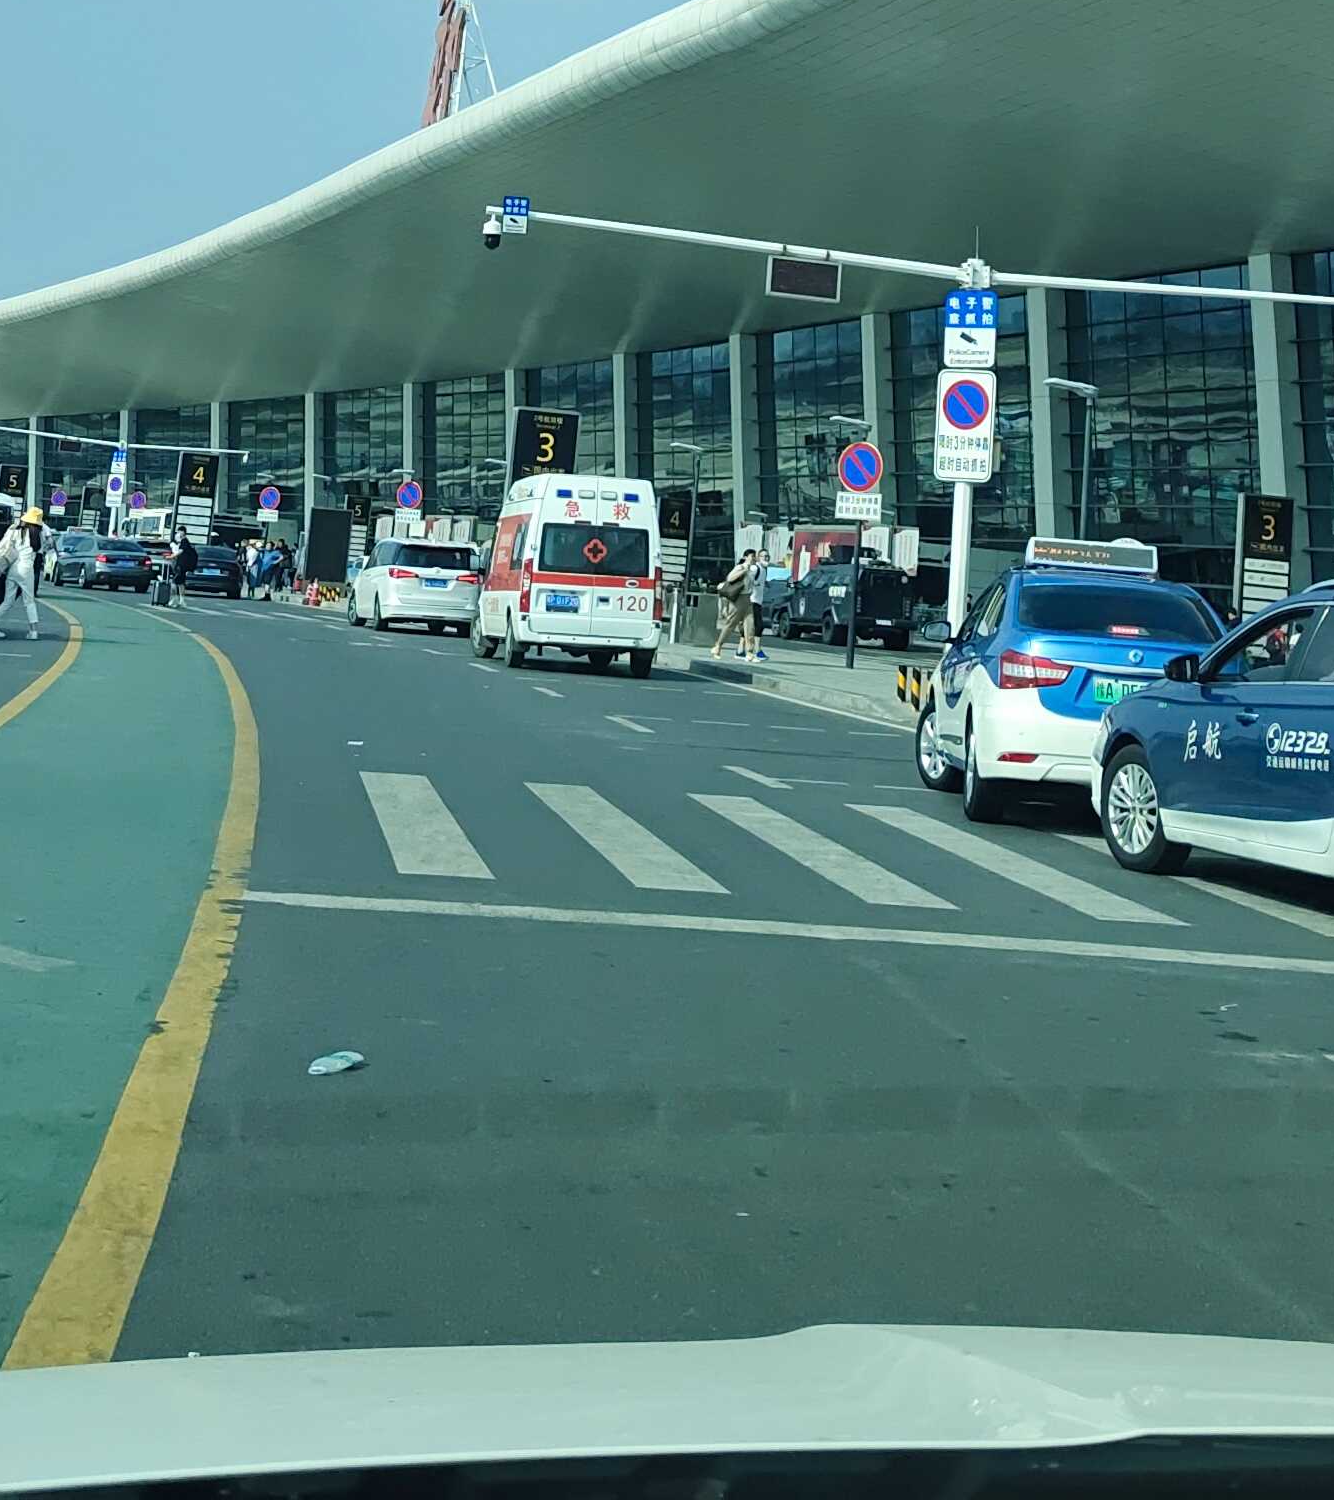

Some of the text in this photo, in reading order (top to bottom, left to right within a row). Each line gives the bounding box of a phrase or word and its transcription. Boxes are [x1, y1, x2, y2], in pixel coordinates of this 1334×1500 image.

[536, 432, 555, 462] 3
[8, 474, 18, 488] 5
[193, 466, 205, 484] 4
[564, 500, 631, 522] 急救
[1261, 515, 1276, 541] 3
[617, 595, 649, 612] 120
